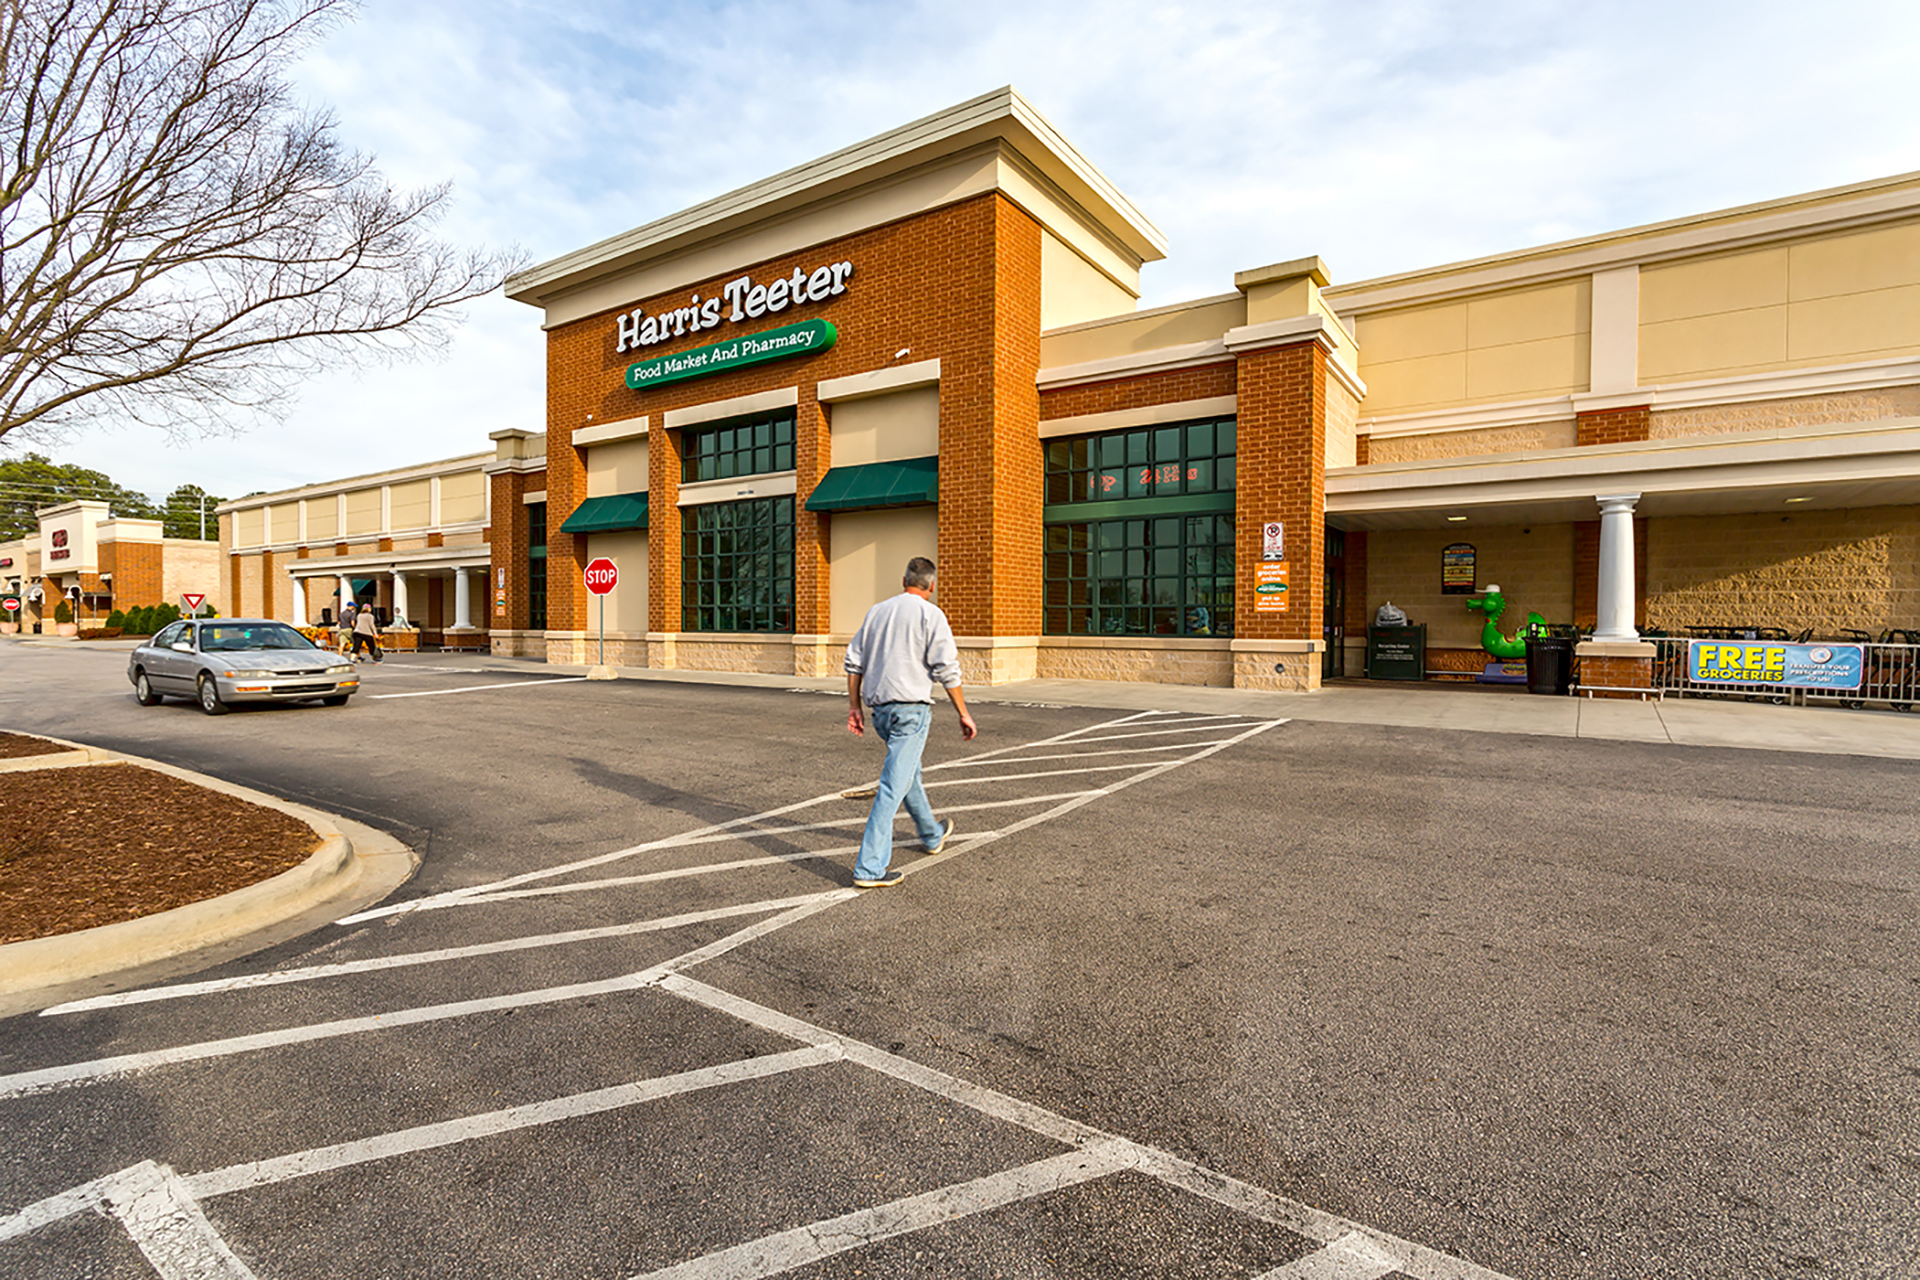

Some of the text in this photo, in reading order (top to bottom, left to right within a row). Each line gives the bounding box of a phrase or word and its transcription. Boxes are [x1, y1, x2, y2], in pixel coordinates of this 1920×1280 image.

[616, 260, 853, 353] Harris Teeter
[633, 328, 816, 381] Food Market And Pharmacy
[587, 569, 616, 584] STOP
[1698, 645, 1785, 671] FREE
[1697, 668, 1784, 682] GROCERIES
[1790, 669, 1849, 677] PRESCRIPTIONS
